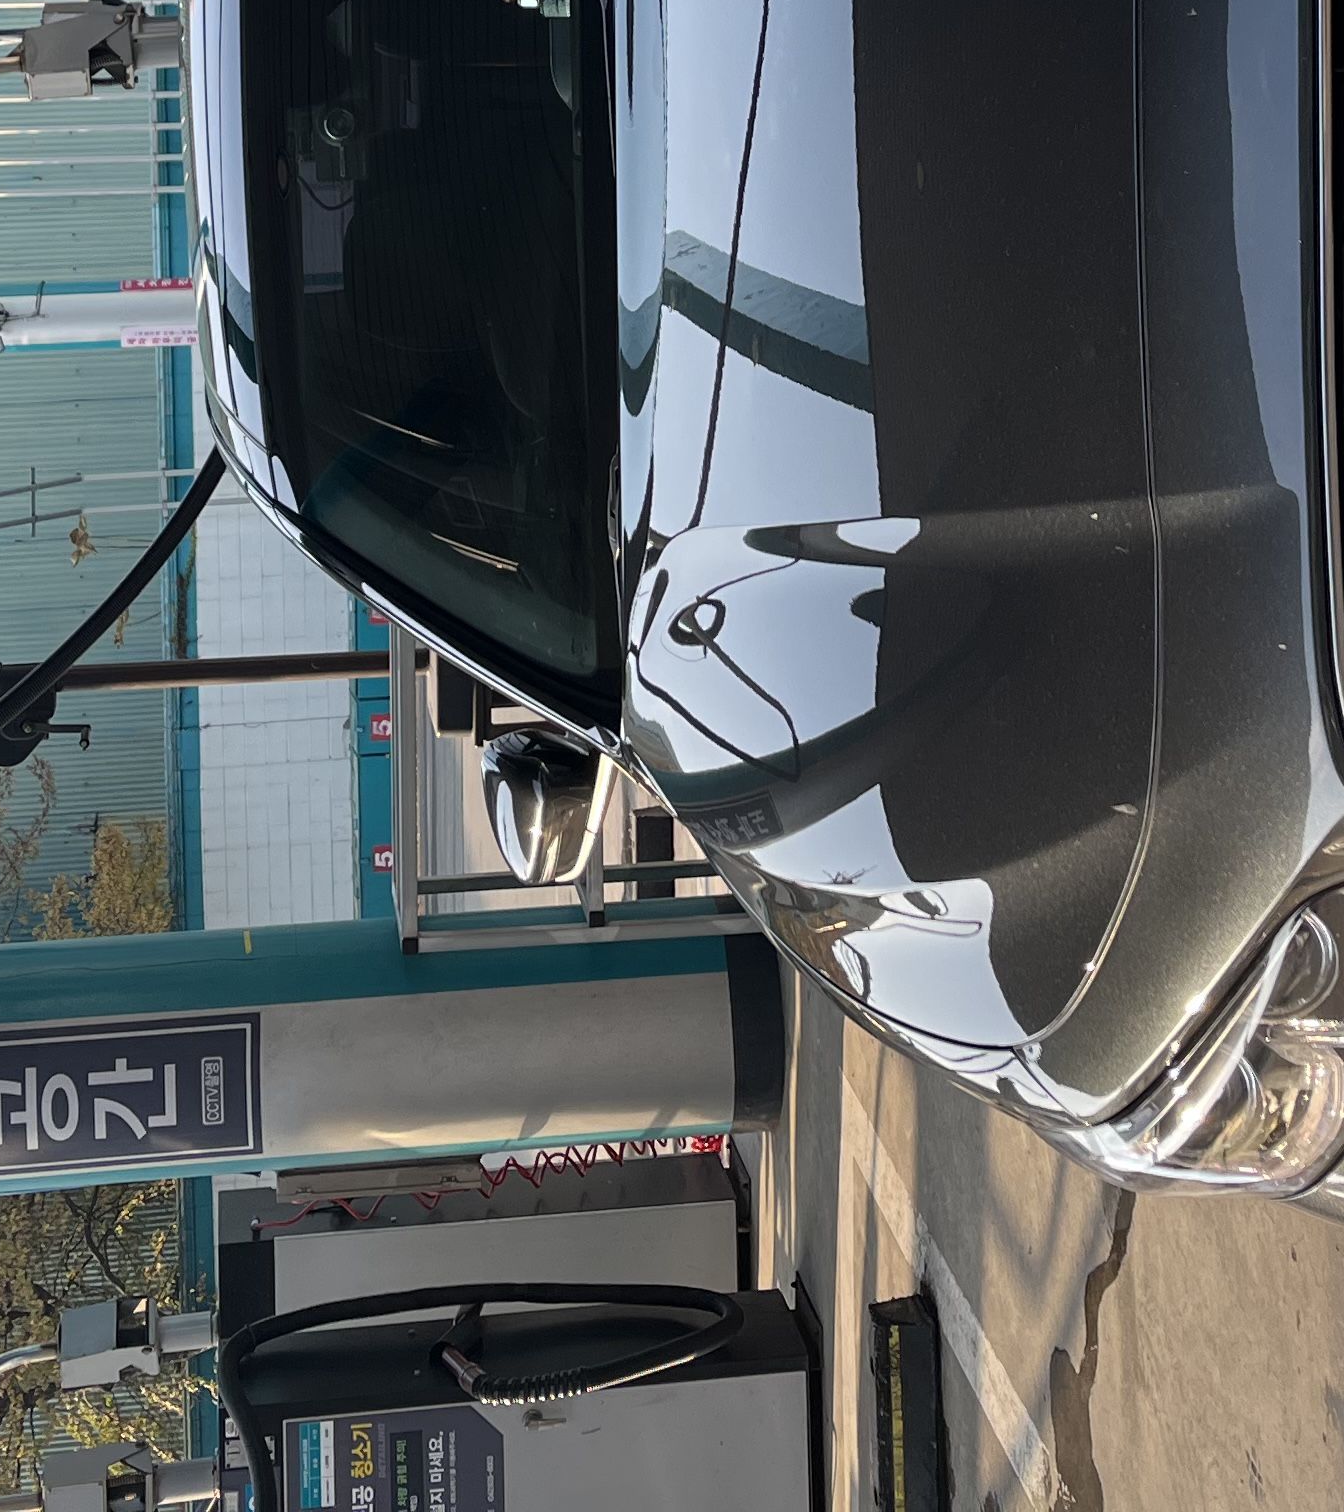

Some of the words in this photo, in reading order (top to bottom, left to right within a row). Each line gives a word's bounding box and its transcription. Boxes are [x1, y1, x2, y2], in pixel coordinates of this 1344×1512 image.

[372, 718, 392, 736] 5
[375, 851, 394, 868] 5
[205, 1062, 220, 1121] CCTV촬영
[350, 1423, 374, 1479] 청소기
[428, 1431, 445, 1483] 마세요.
